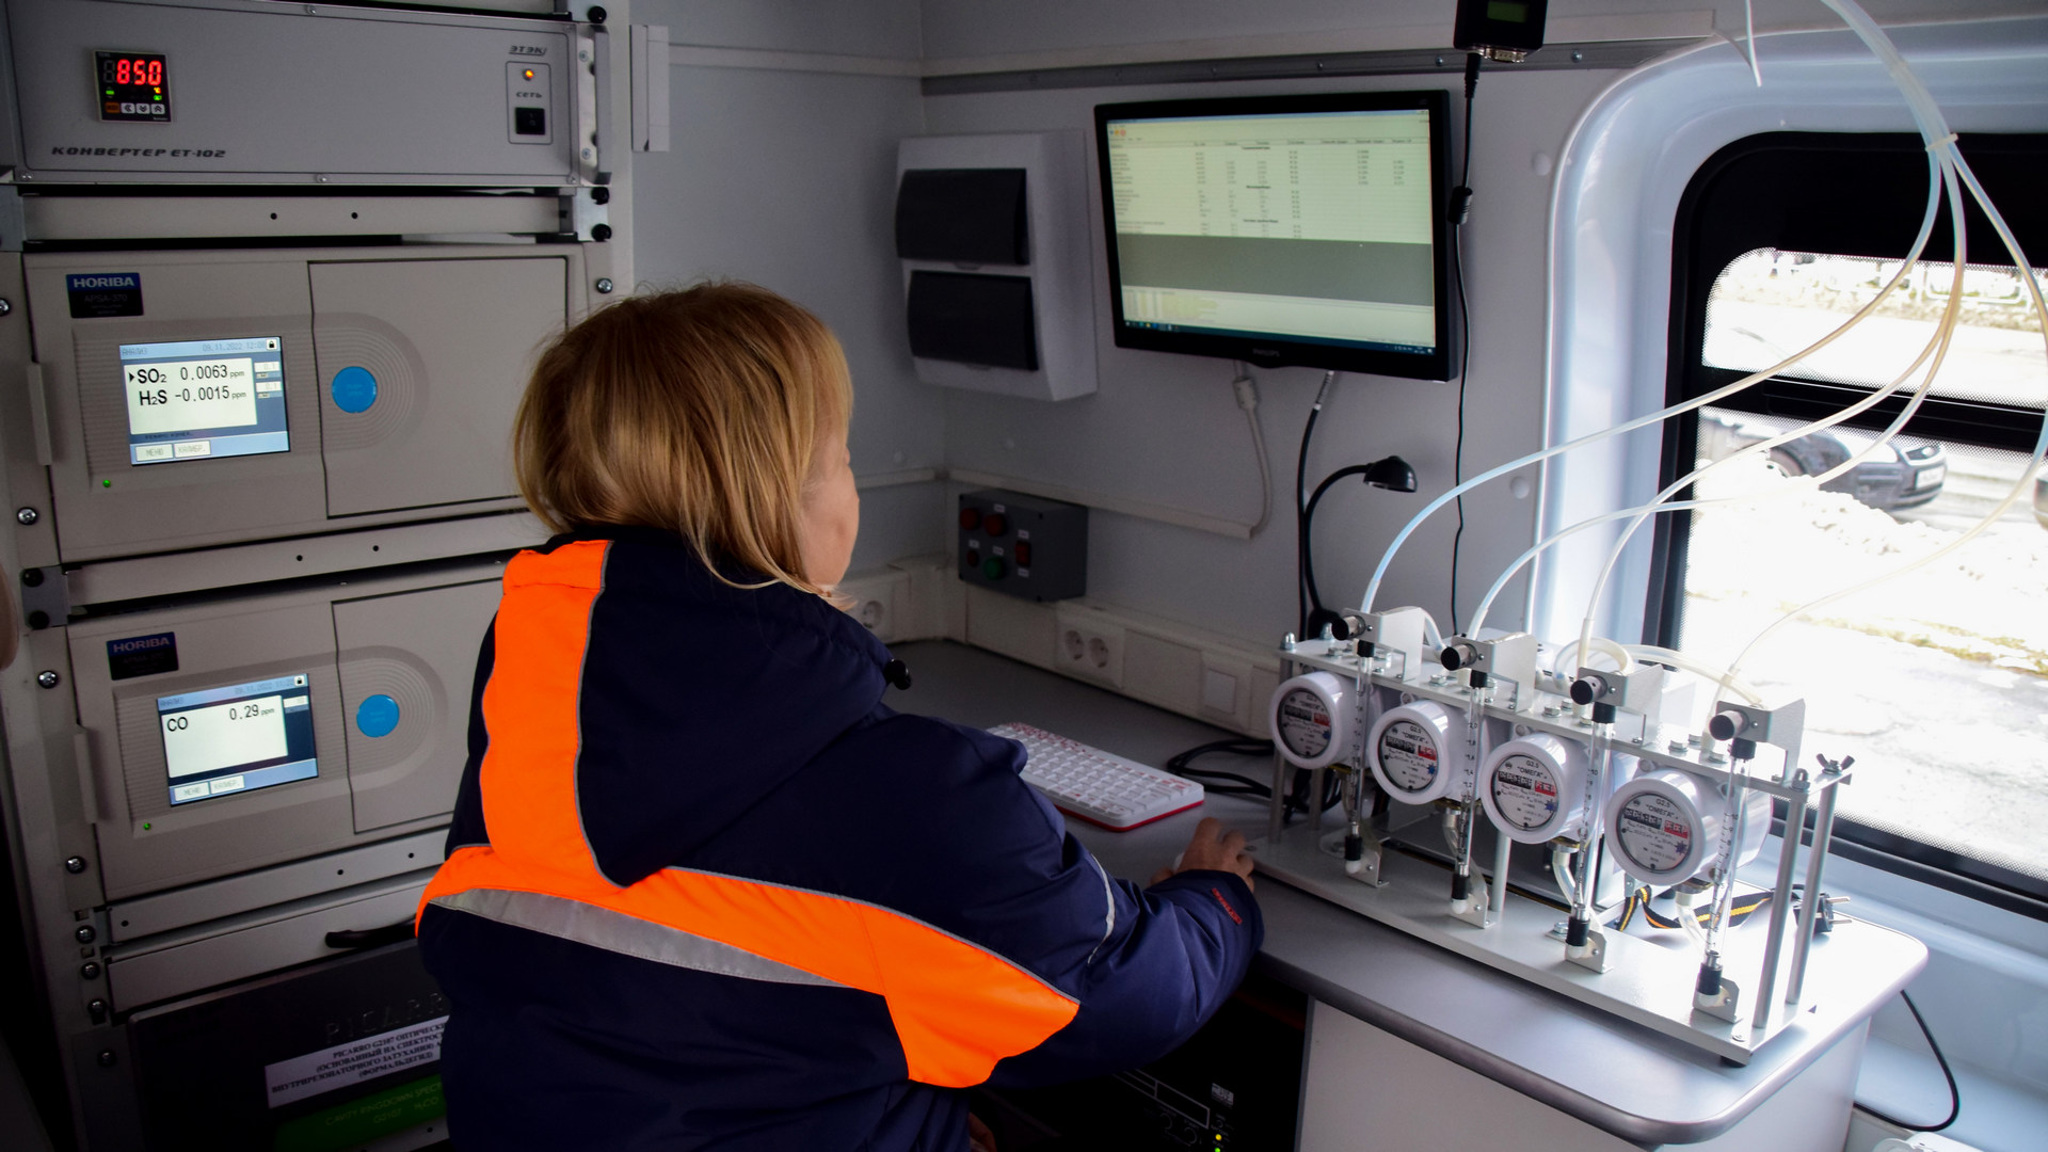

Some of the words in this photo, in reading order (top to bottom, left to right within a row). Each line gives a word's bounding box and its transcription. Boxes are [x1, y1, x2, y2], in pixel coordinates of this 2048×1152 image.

[116, 59, 162, 86] 850
[52, 147, 167, 157] КОНВЕРТЕР
[73, 276, 135, 288] HORIBA
[180, 365, 228, 381] 0.0063
[230, 371, 245, 379] ppm
[175, 386, 230, 402] -0.0015
[231, 392, 247, 400] ppm
[112, 636, 171, 653] HORIBA
[167, 716, 188, 732] CO
[229, 704, 259, 721] 0.29
[333, 1043, 371, 1058] PICARRO
[383, 1045, 395, 1056] НА
[324, 1109, 358, 1126] CAVITY
[359, 1092, 413, 1115] RINGDOWN
